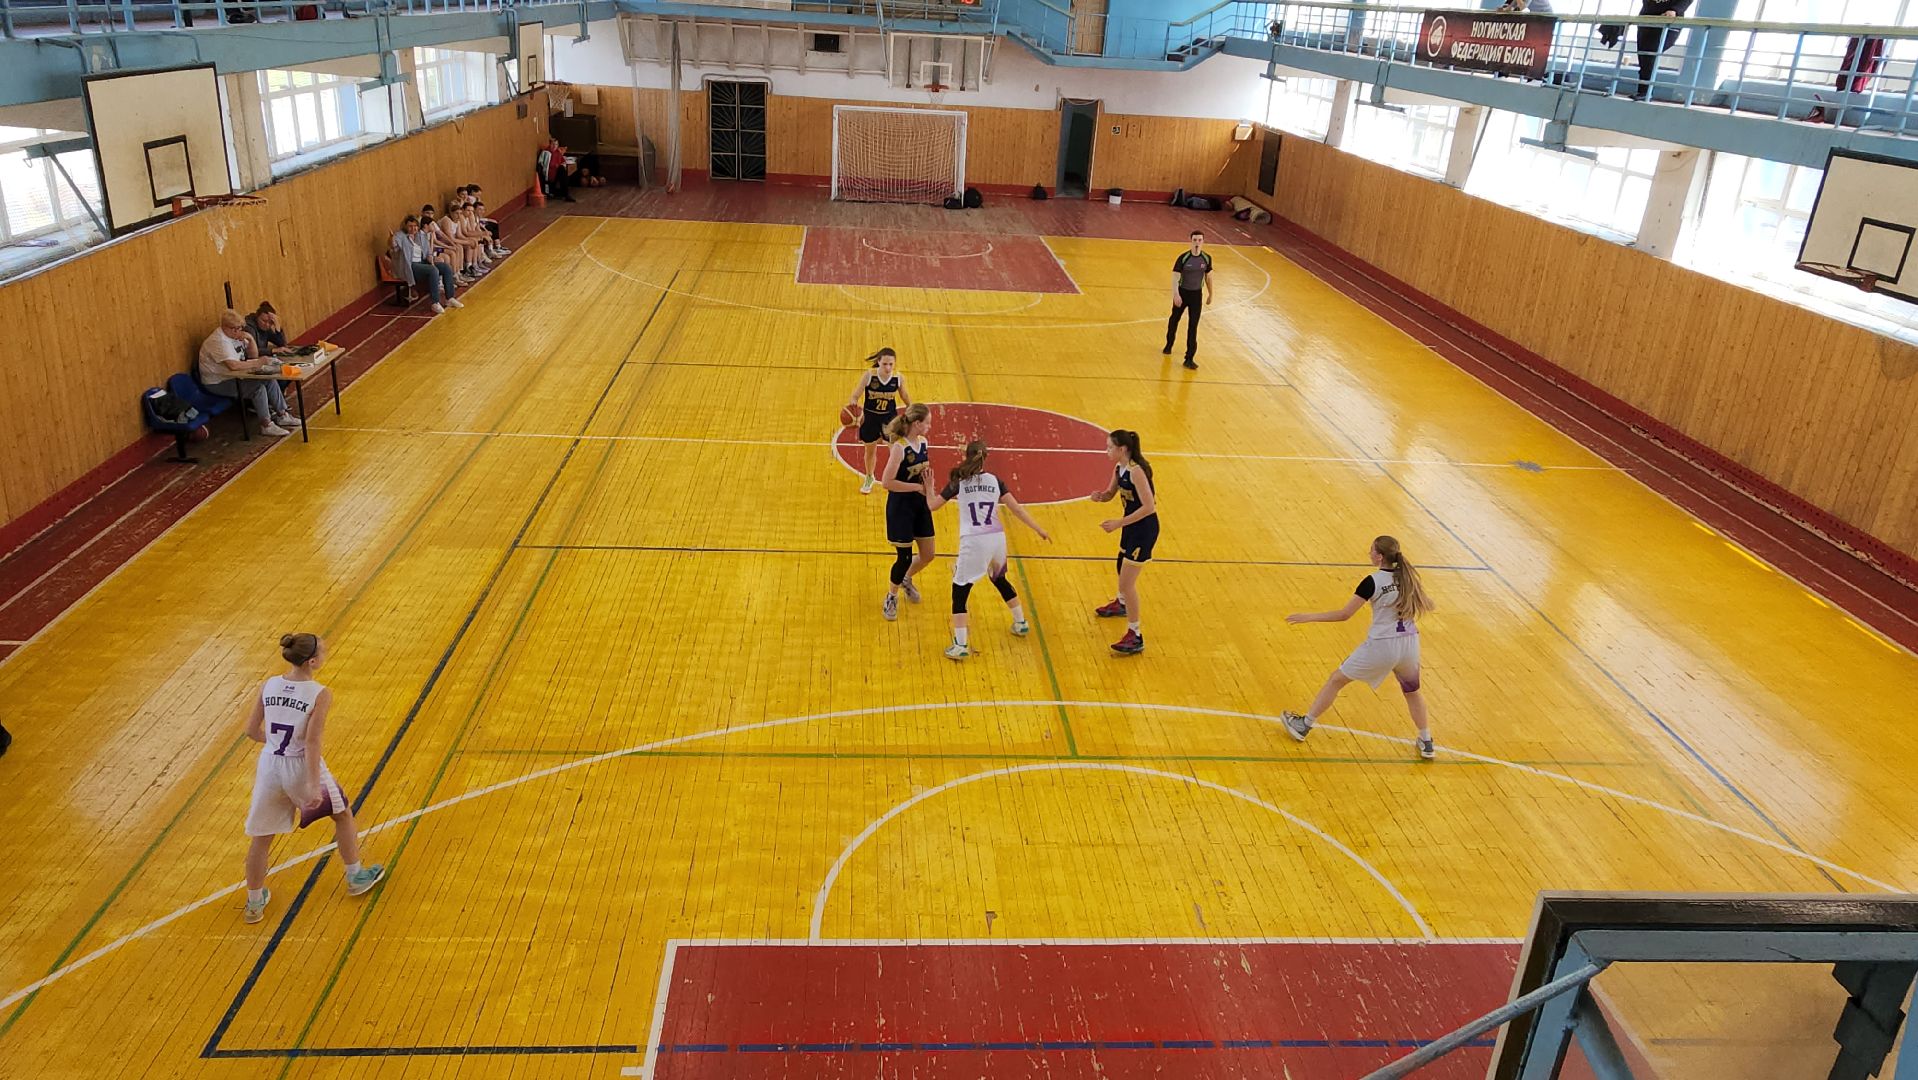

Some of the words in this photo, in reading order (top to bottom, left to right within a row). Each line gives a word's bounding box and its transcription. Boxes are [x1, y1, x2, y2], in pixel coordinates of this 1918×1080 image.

[1471, 21, 1527, 41] НОГИНСКАЯ
[1450, 41, 1503, 64] ФЕДЕРАЦИЯ
[875, 399, 888, 411] 20
[964, 484, 996, 494] НОГИНСК
[967, 501, 995, 526] 17
[265, 696, 309, 713] НОГИНСК
[270, 722, 295, 756] 7
